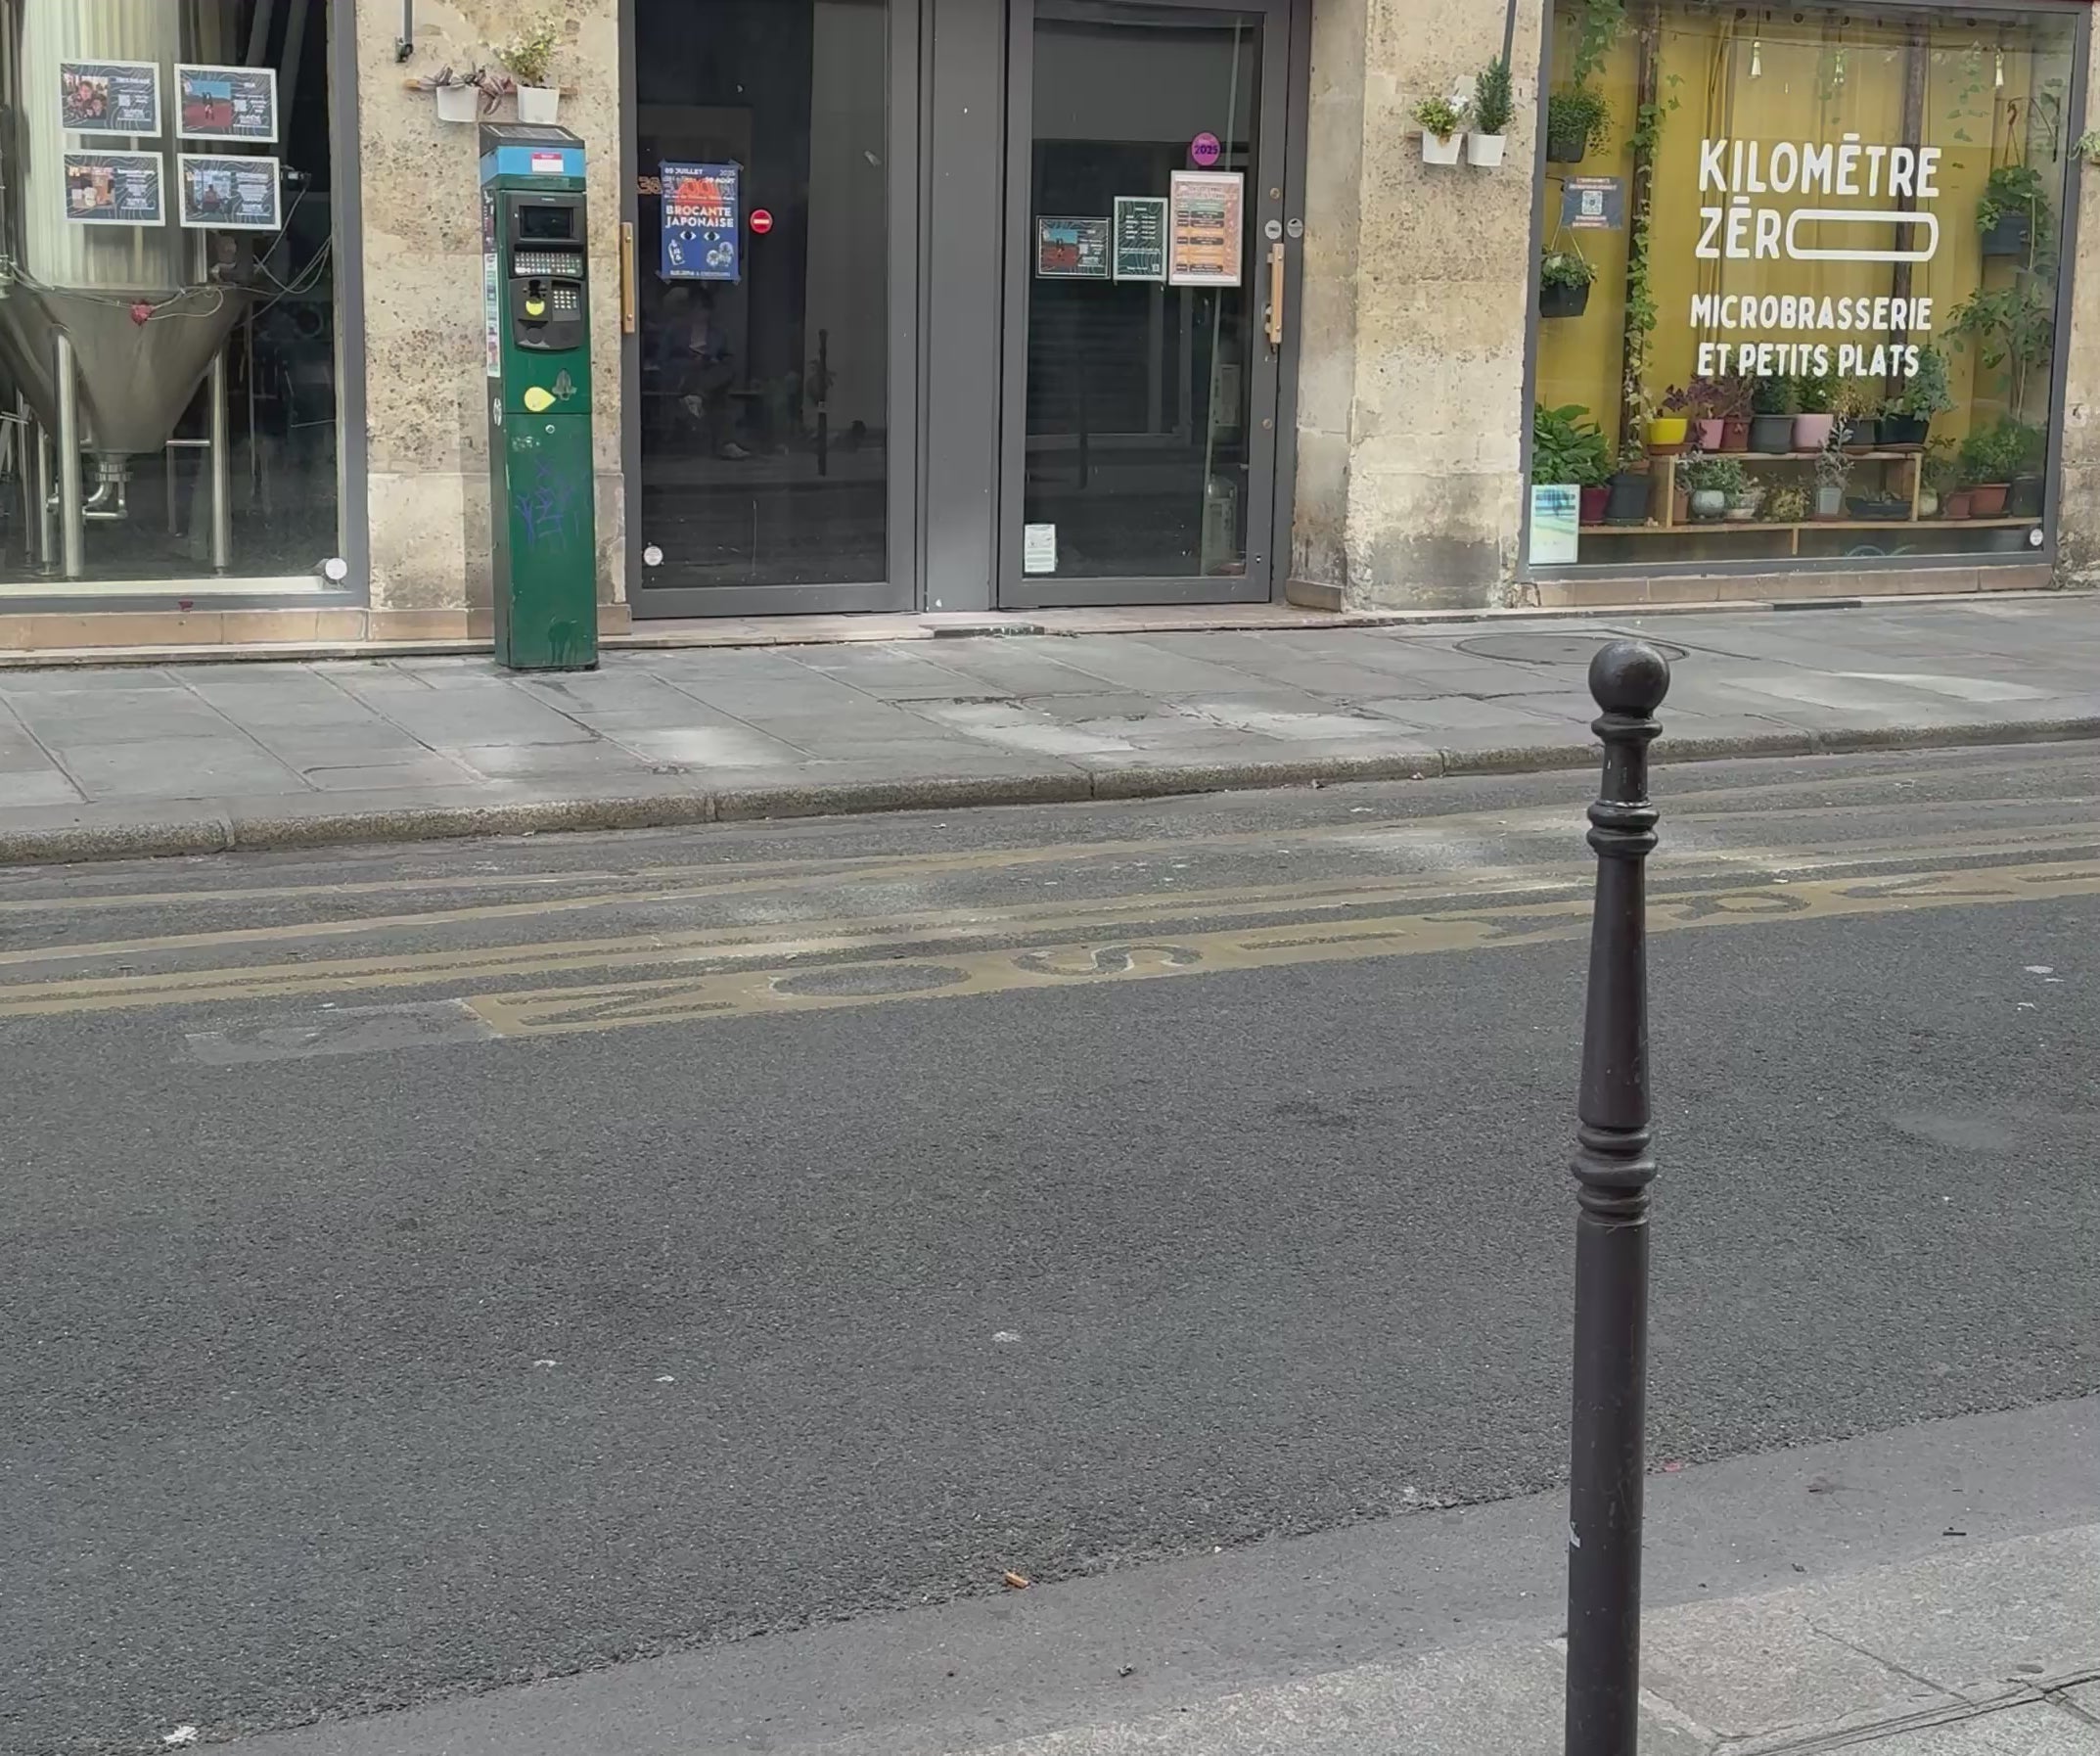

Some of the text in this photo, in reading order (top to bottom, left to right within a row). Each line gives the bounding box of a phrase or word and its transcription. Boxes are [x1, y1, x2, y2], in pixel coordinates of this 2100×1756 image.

[1194, 144, 1218, 155] 2025
[674, 167, 703, 176] JUILLET
[665, 205, 732, 216] BROCANTE
[664, 217, 734, 228] JAPONAISE
[1690, 294, 1934, 331] MICROBRASSERIE
[1697, 343, 1920, 378] ET PETITS PLATS
